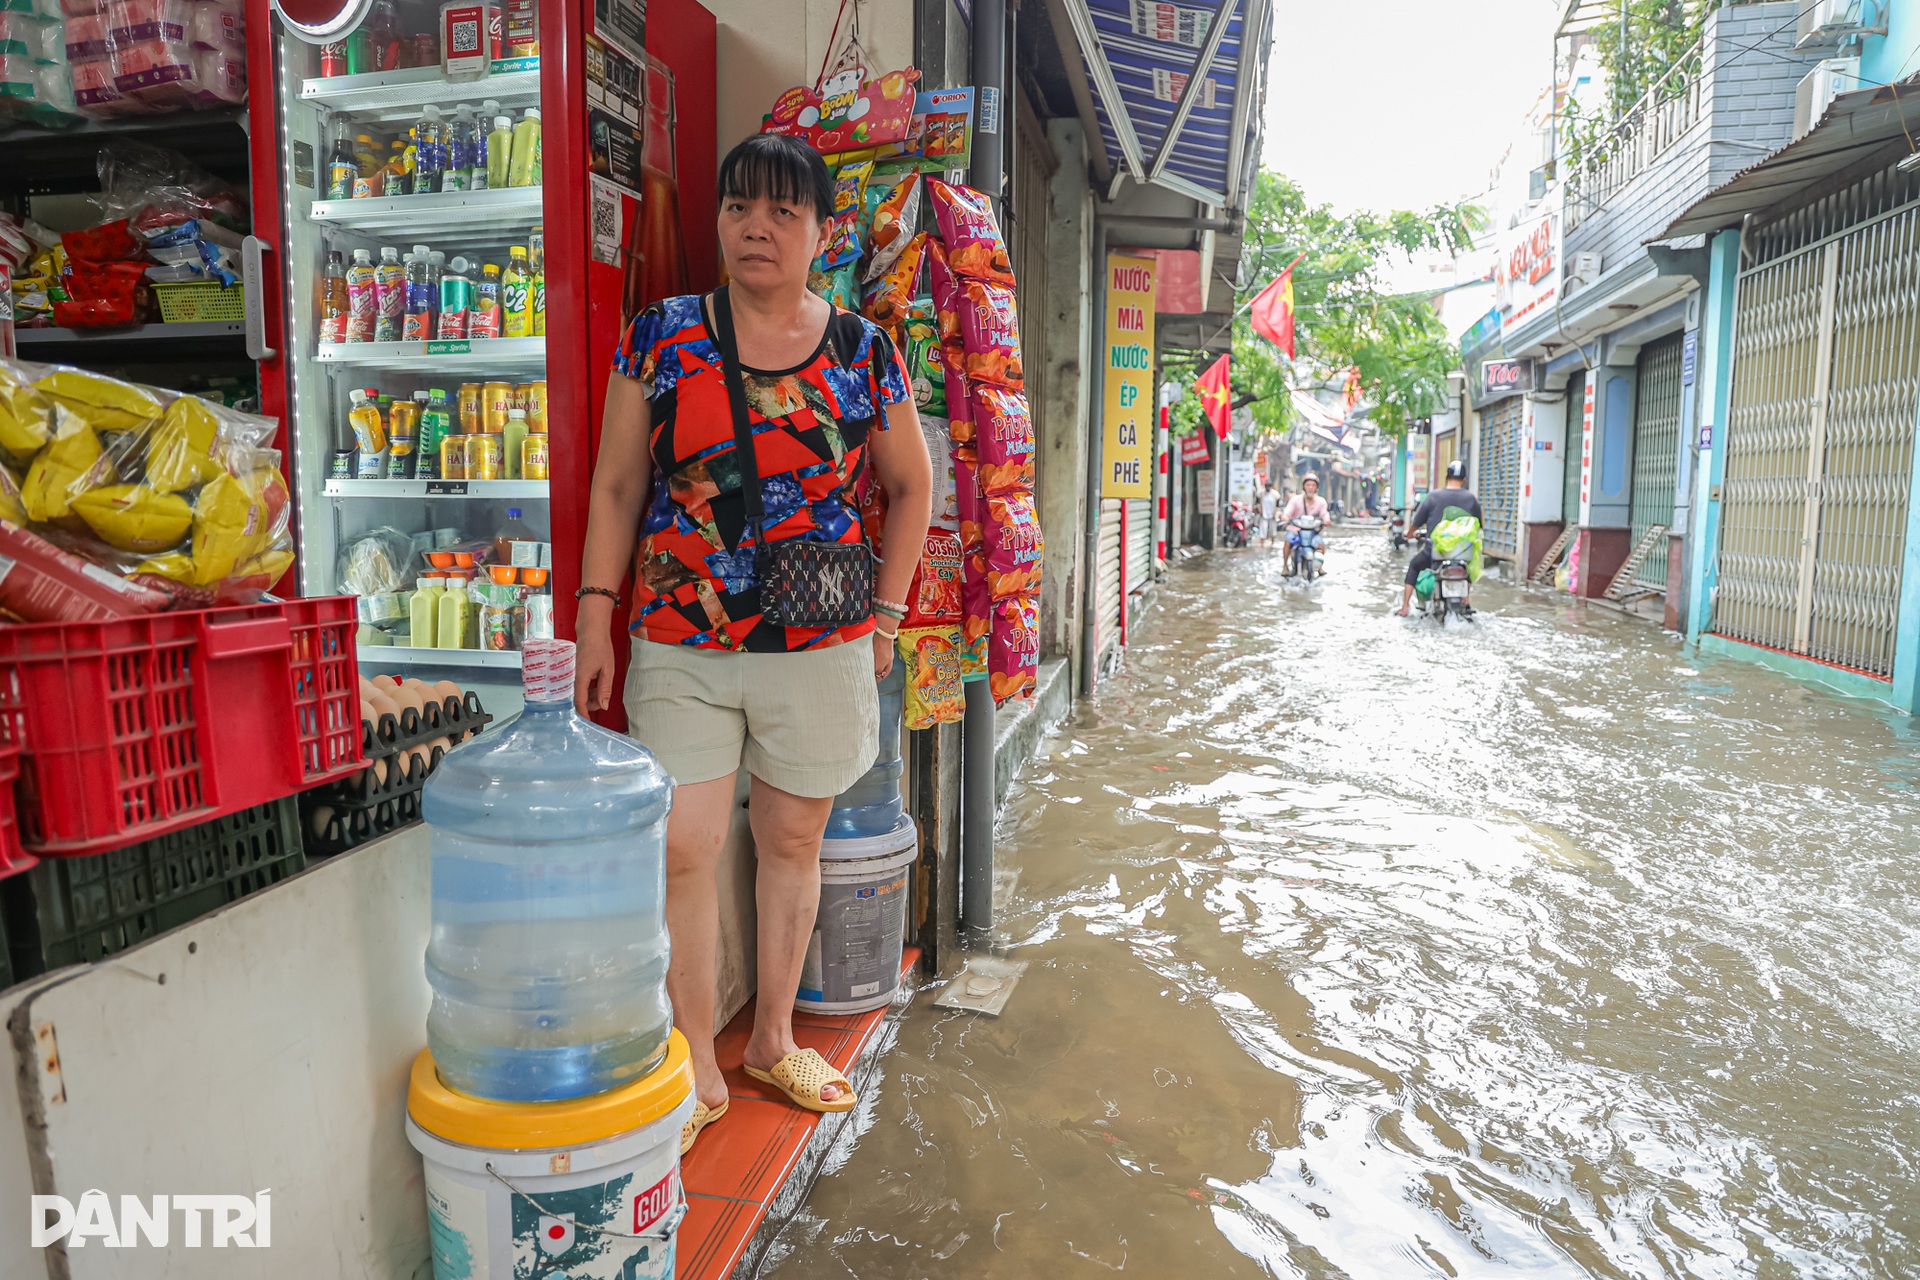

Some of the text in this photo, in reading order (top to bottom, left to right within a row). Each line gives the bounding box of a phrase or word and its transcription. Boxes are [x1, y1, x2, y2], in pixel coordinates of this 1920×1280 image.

[524, 59, 540, 70] Sprit
[941, 92, 967, 103] ORION
[1113, 264, 1151, 293] NƯỚC
[505, 284, 527, 312] C2
[1117, 303, 1144, 331] MÍA
[1110, 342, 1149, 370] NƯỚC
[1120, 380, 1137, 407] ÉP
[1119, 419, 1137, 446] CÀ
[1114, 458, 1140, 484] PHÊ
[926, 537, 960, 558] Oishi
[938, 568, 954, 582] Cay
[929, 650, 958, 666] Snack
[637, 1173, 676, 1228] GOLD
